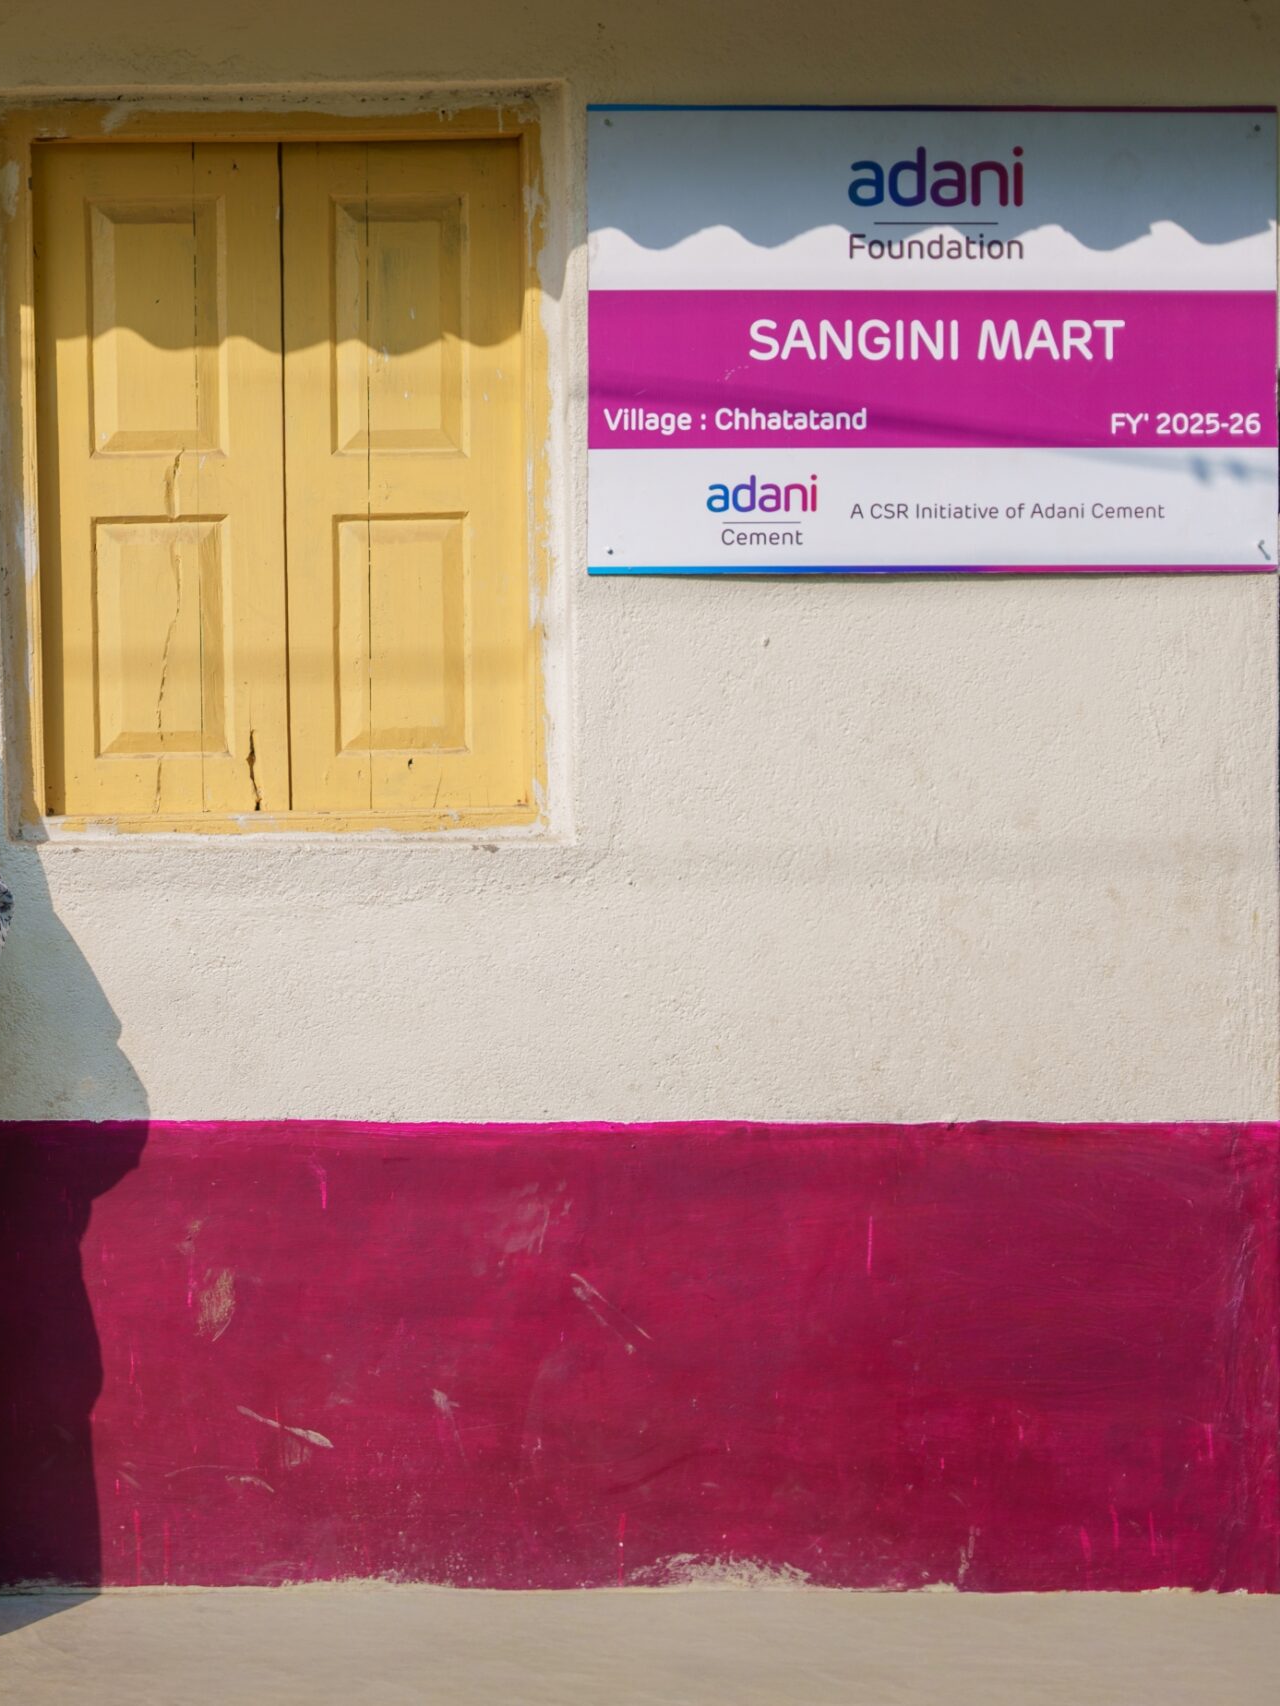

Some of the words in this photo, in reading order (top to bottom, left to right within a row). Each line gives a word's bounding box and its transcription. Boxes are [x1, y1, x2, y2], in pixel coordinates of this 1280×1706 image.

[847, 145, 1024, 207] adani
[849, 233, 1024, 260] Foundation
[748, 318, 959, 361] SANGINI
[977, 319, 1126, 361] MART
[603, 407, 693, 435] Village
[700, 413, 707, 431] :
[714, 407, 867, 431] Chhatatand
[1110, 412, 1149, 435] FY'
[1156, 412, 1262, 435] 2025-26
[706, 474, 818, 513] adani
[850, 503, 864, 519] A
[870, 503, 909, 520] CSR
[916, 503, 999, 519] Initiative
[1005, 502, 1025, 519] of
[1030, 503, 1085, 519] Adani
[1091, 503, 1165, 519] Cement
[721, 528, 804, 546] Cement
